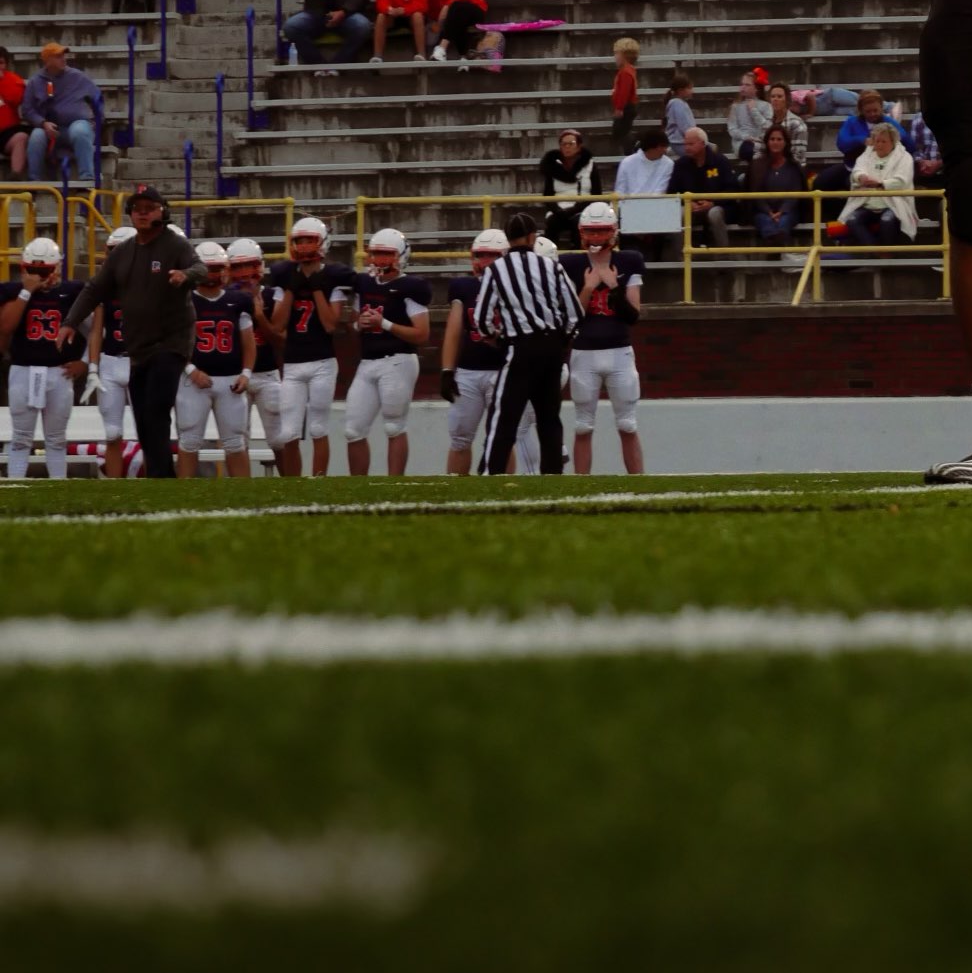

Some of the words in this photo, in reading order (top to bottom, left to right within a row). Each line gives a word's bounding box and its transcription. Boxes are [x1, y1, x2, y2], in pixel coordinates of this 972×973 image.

[26, 308, 62, 341] 63
[293, 299, 315, 333] 7
[194, 319, 235, 354] 58
